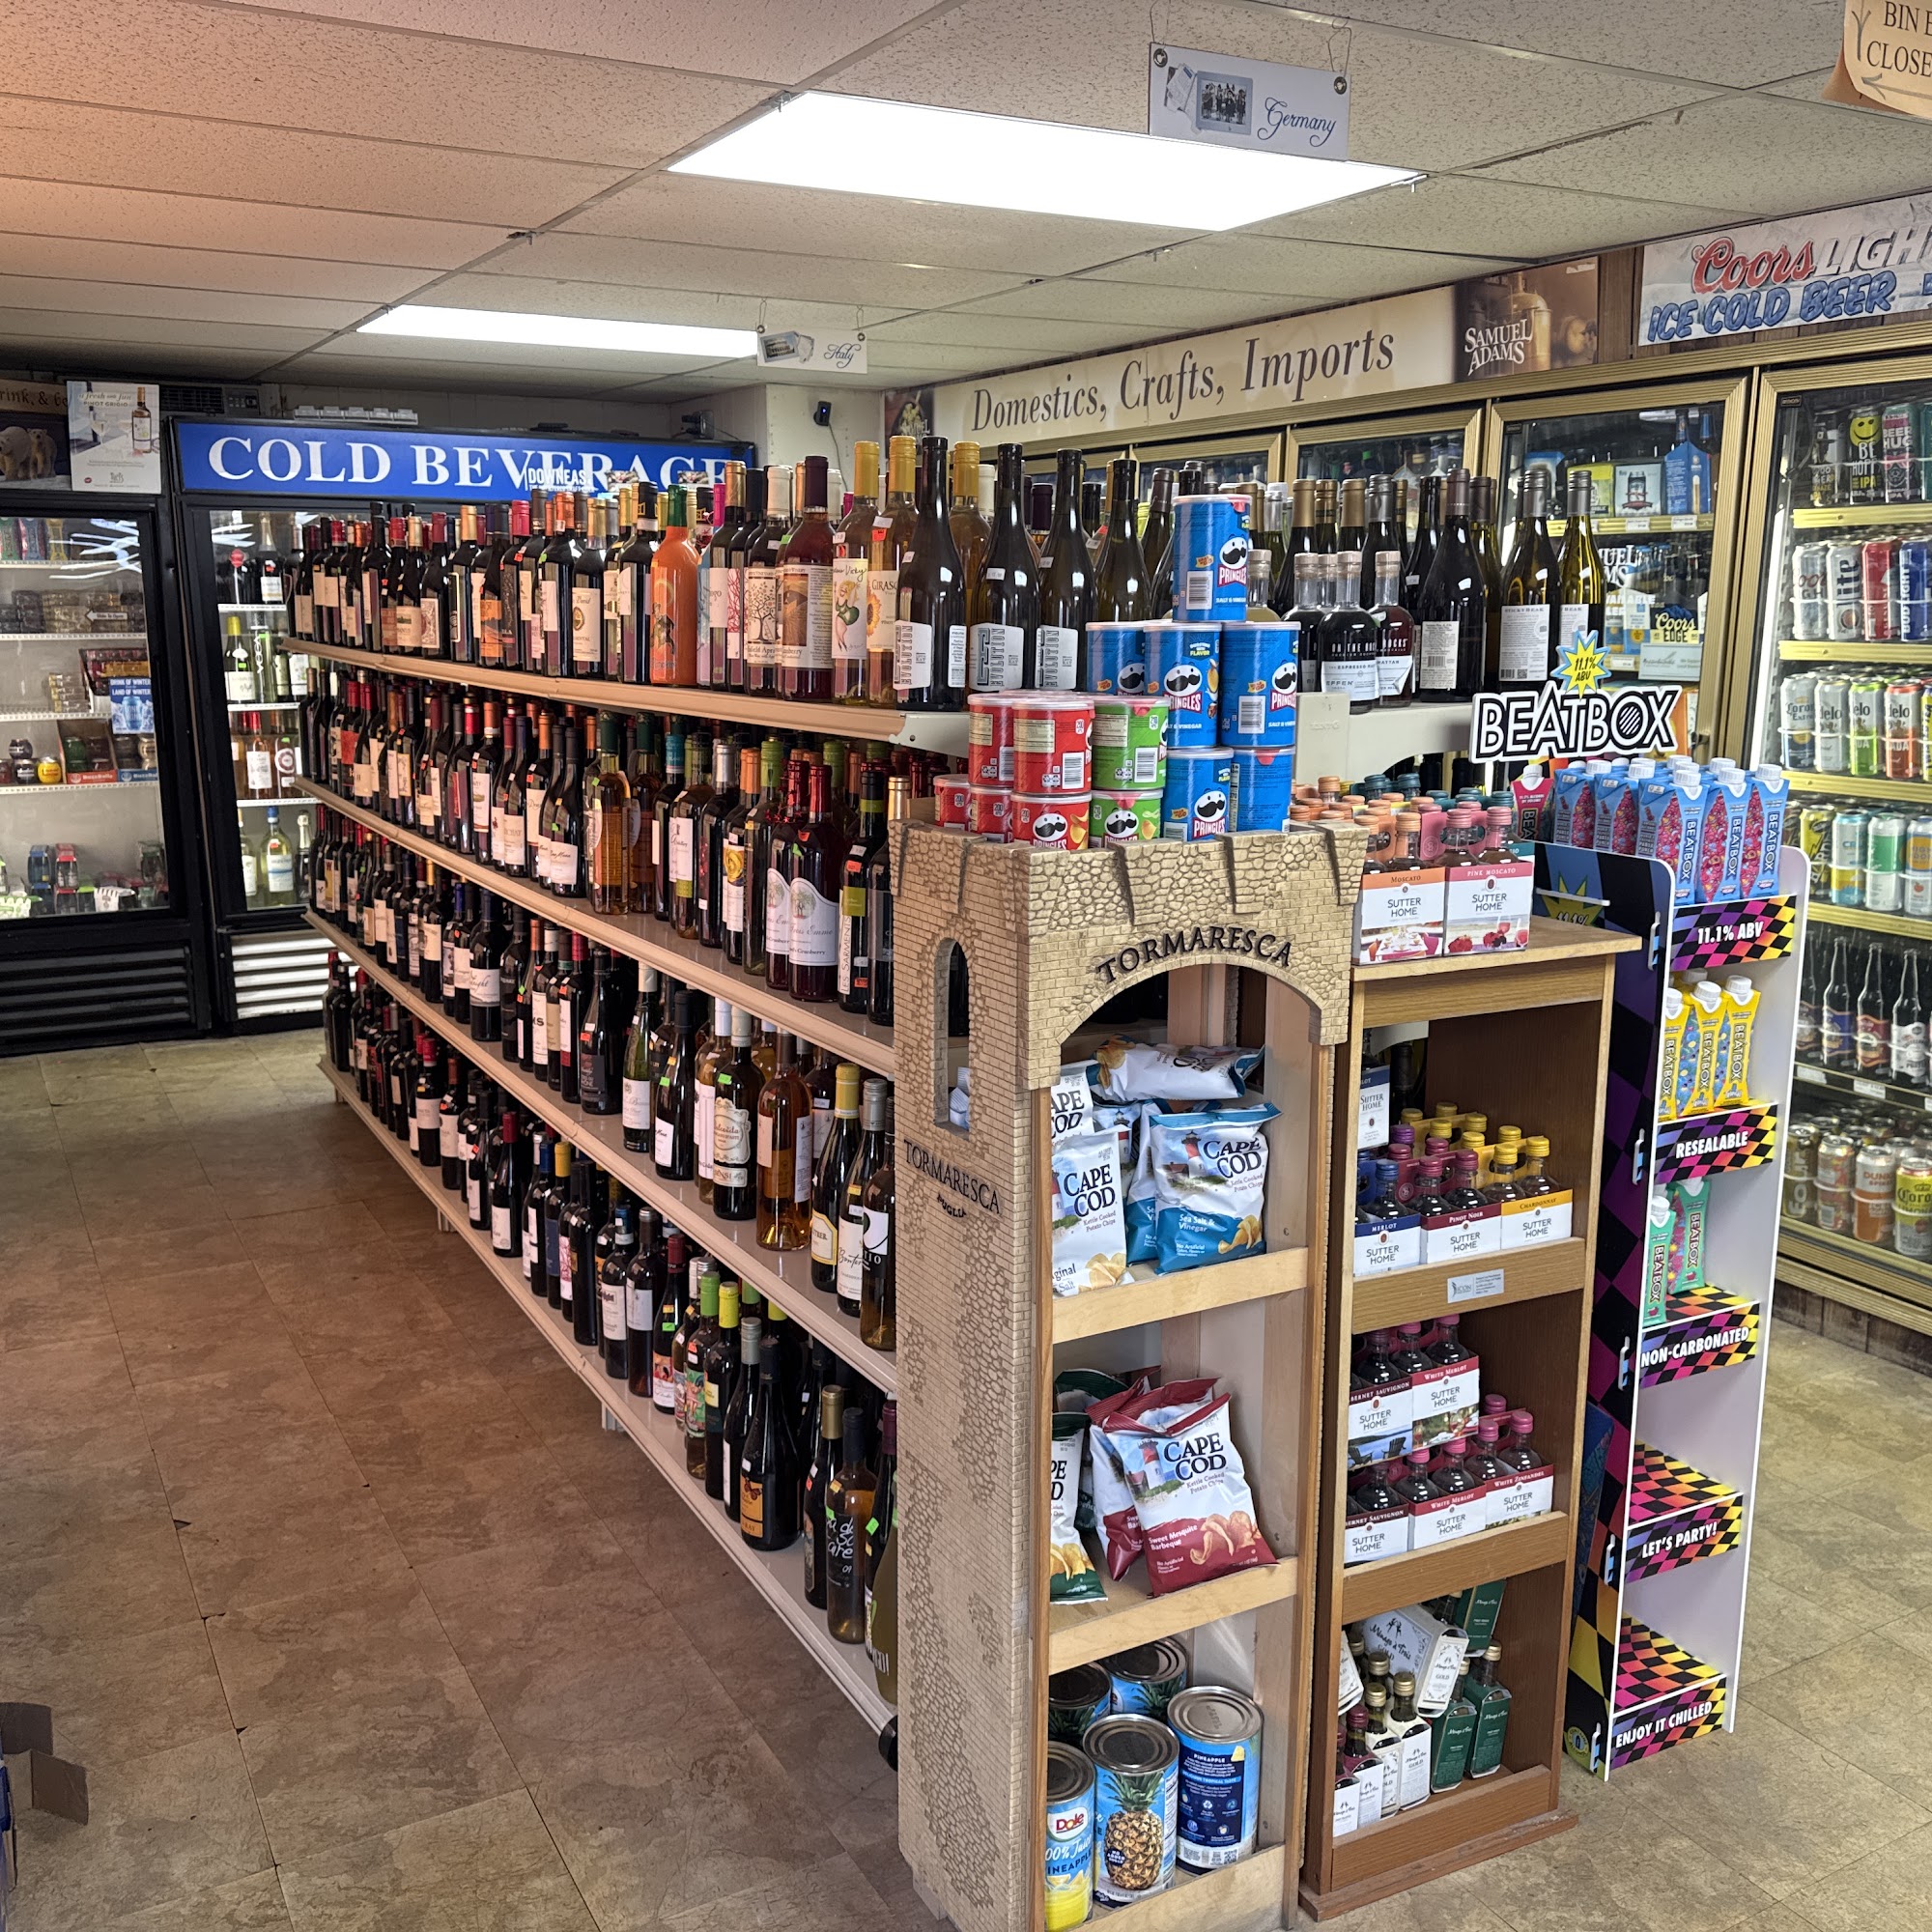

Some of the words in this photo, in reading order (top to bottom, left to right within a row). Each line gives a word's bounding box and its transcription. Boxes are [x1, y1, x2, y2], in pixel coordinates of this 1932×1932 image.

[1884, 2, 1919, 33] BIN
[1257, 97, 1337, 148] Germany
[1692, 237, 1816, 295] Coors
[1814, 224, 1932, 278] LIGH
[1647, 298, 1698, 342] ICE
[1702, 287, 1790, 334] COLD
[1799, 270, 1897, 322] BEER
[1464, 319, 1533, 354] SAMUEL
[824, 342, 862, 369] Italy
[1467, 341, 1525, 376] ADAMS
[972, 374, 1107, 432] Domestics,
[1121, 350, 1225, 421] Crafts,
[1240, 328, 1394, 403] Imports
[39, 390, 49, 406] &
[1883, 427, 1913, 438] BEER
[1859, 441, 1876, 460] BE
[1883, 437, 1913, 449] HUG
[208, 437, 391, 483] COLD
[527, 468, 592, 486] DOWNEAS
[1219, 566, 1247, 585] PRINGLES
[1655, 611, 1696, 629] Coors
[1662, 629, 1689, 642] EDGE
[1575, 656, 1597, 672] 11.1%
[1576, 670, 1591, 682] ABV
[1786, 702, 1814, 715] Coro
[1475, 688, 1681, 760] BEATBOX
[1193, 817, 1226, 838] PRINGLES
[1681, 821, 1697, 880] BEATBOX
[1727, 818, 1743, 876] BEATBOX
[1764, 813, 1779, 871] BEATBOX
[1391, 874, 1421, 884] MOSCATO
[1485, 867, 1517, 876] MOSCATO
[1387, 896, 1422, 908] SUTTER
[1471, 894, 1507, 904] SUTTER
[1475, 902, 1503, 912] HOME
[1391, 906, 1418, 918] HOME
[1697, 924, 1735, 945] 11.1%
[1737, 921, 1765, 942] ABV
[1095, 925, 1294, 983] TORMARESCA
[1698, 1031, 1713, 1090] BEATBOX
[1731, 1023, 1746, 1082] BEATBOX
[1660, 1038, 1676, 1097] BEATBOX
[1360, 1094, 1384, 1105] SUTTER
[1362, 1101, 1382, 1110] HOME
[1203, 1138, 1262, 1160] CAPE
[1675, 1130, 1748, 1159] RESEALABLE
[1216, 1151, 1262, 1179] COD
[903, 1139, 1002, 1215] TORMARESCA
[1064, 1164, 1113, 1197] CAPE
[1073, 1187, 1116, 1218] COD
[1519, 1197, 1557, 1209] CHARDONNAY
[1897, 1186, 1932, 1205] Coro
[1083, 1215, 1097, 1226] Kettle
[1098, 1210, 1116, 1223] Cooked
[1086, 1222, 1100, 1233] Potato
[1101, 1218, 1116, 1230] Chips
[1449, 1214, 1466, 1223] PINOT
[1467, 1211, 1484, 1220] NOIR
[1522, 1218, 1552, 1231] SUTTER
[1179, 1222, 1208, 1233] Vinegar
[1372, 1222, 1397, 1232] MERLOT
[1525, 1227, 1548, 1238] HOME
[1450, 1232, 1481, 1245] SUTTER
[1453, 1240, 1477, 1253] HOME
[1687, 1212, 1702, 1267] BEATBOX
[1366, 1245, 1400, 1258] SUTTER
[1370, 1253, 1396, 1264] HOME
[1650, 1245, 1665, 1303] BEATBOX
[1640, 1326, 1749, 1369] NON-CARBONATED
[1424, 1370, 1445, 1380] WHITE
[1445, 1364, 1467, 1376] MERLOT
[1375, 1380, 1410, 1397] SAUVIGNON
[1431, 1385, 1461, 1401] SUTTER
[1434, 1395, 1458, 1408] HOME
[1359, 1408, 1392, 1425] SUTTER
[1363, 1418, 1388, 1431] HOME
[1163, 1433, 1224, 1464] CAPE
[1175, 1454, 1227, 1481] COD
[1186, 1479, 1202, 1489] Kettle
[1203, 1472, 1225, 1485] Cooked
[1493, 1478, 1514, 1488] WHITE
[1514, 1470, 1546, 1485] ZINFANDEL
[1190, 1484, 1207, 1494] Potato
[1431, 1499, 1451, 1510] WHITE
[1451, 1492, 1475, 1505] MERLOT
[1503, 1492, 1533, 1505] SUTTER
[1506, 1500, 1529, 1513] HOME
[1369, 1509, 1405, 1522] SAUVIGNON
[1436, 1514, 1466, 1528] SUTTER
[1148, 1534, 1168, 1545] Sweet
[1169, 1524, 1198, 1541] Mesquite
[1439, 1523, 1463, 1536] HOME
[1151, 1539, 1182, 1550] Barbeque
[1352, 1533, 1385, 1547] SUTTER
[1355, 1542, 1381, 1554] HOME
[1641, 1534, 1674, 1559] LET'S
[1674, 1521, 1718, 1549] PARTY!
[1615, 1721, 1653, 1748] ENJOY
[1655, 1716, 1667, 1735] IT
[1668, 1700, 1713, 1728] CHILLED
[1193, 1752, 1226, 1763] PINEAPPLE
[1055, 1813, 1085, 1832] Dole
[1045, 1844, 1070, 1861] 00%
